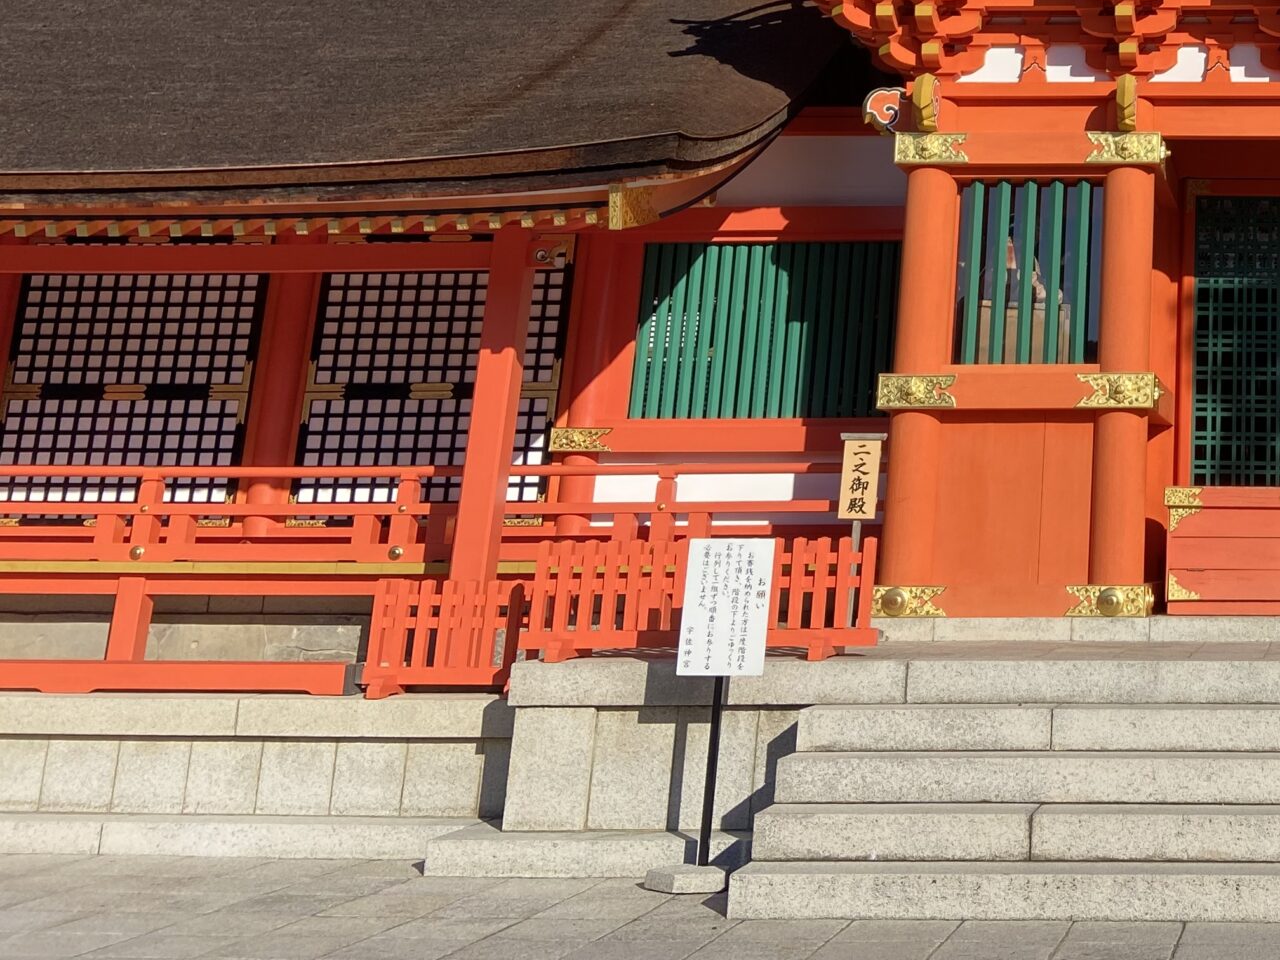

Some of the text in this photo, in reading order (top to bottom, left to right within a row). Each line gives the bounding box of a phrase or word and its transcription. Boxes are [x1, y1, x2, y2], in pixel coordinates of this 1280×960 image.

[846, 444, 871, 514] 二之御殿
[755, 577, 766, 610] お願い
[683, 626, 694, 668] 宇佐神宮
